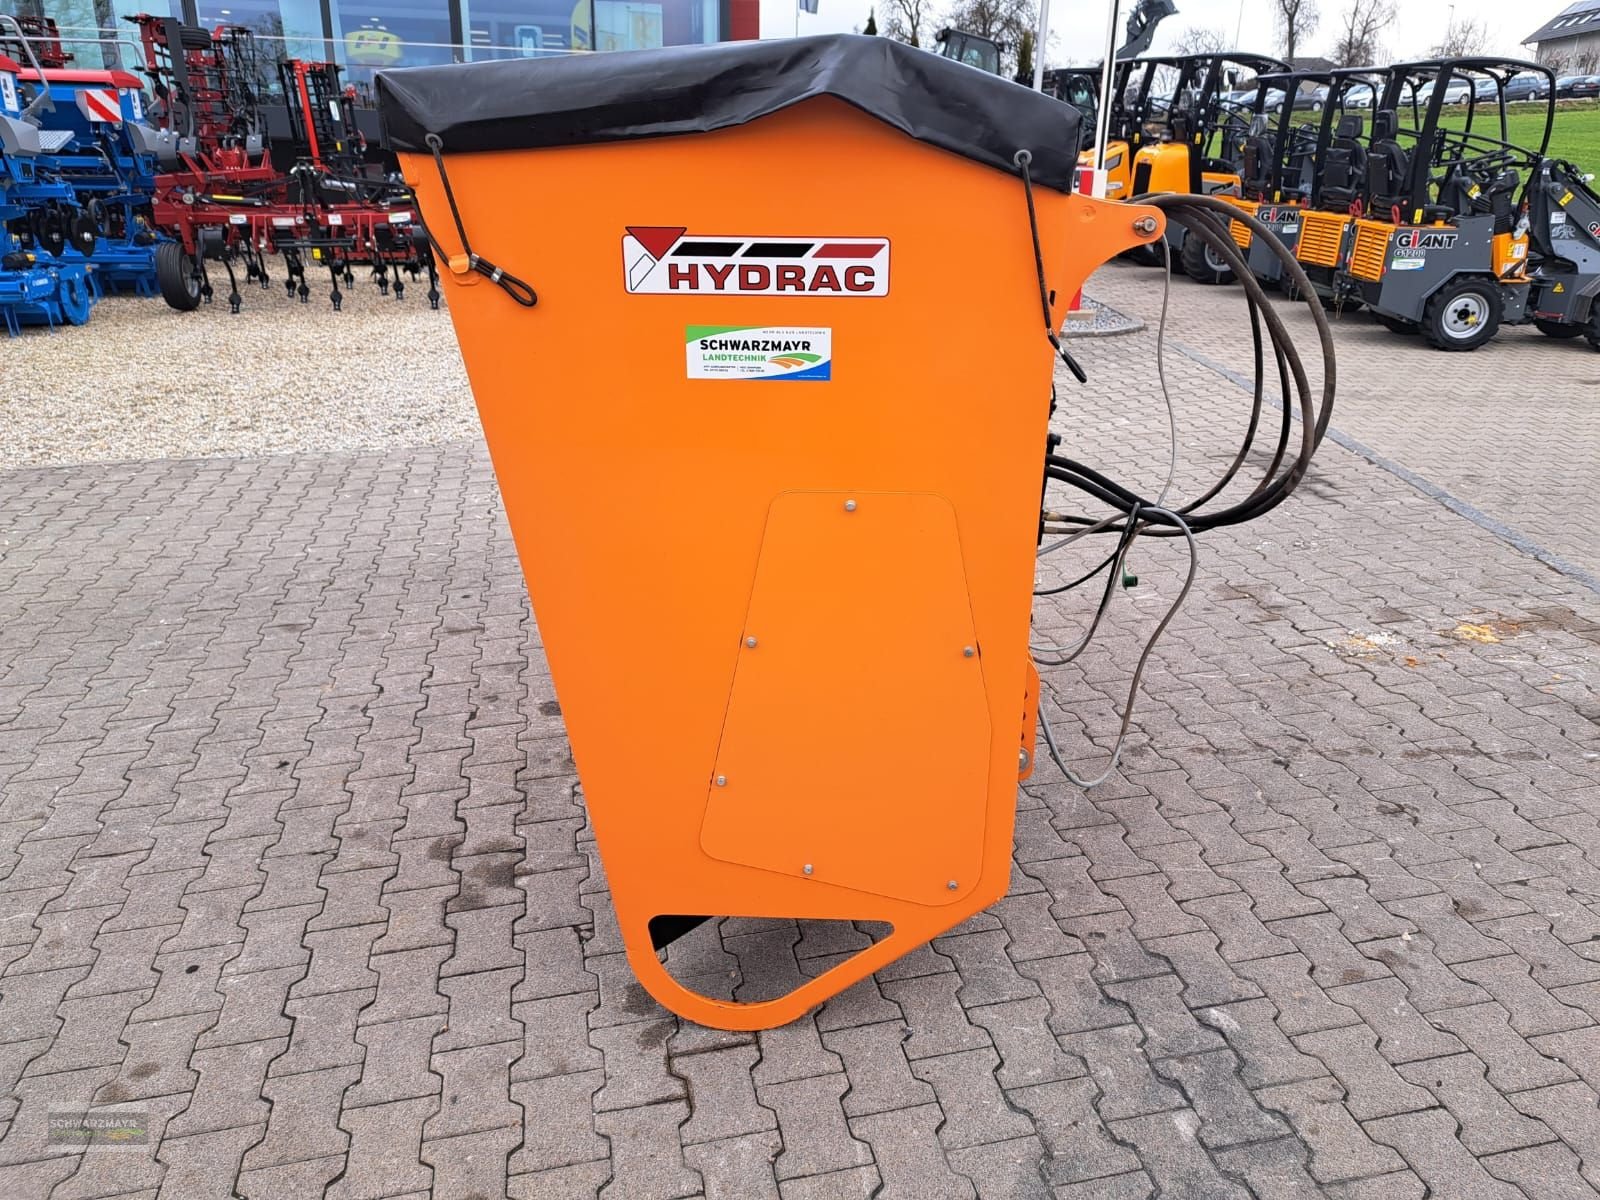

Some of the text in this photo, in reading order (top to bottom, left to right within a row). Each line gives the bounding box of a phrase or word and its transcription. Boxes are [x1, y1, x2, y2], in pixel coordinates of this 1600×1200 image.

[1394, 248, 1426, 257] G1200
[668, 263, 875, 292] HYDRAC
[700, 339, 811, 351] SCHWARZMAYR
[702, 353, 767, 362] LANDTECHNIK
